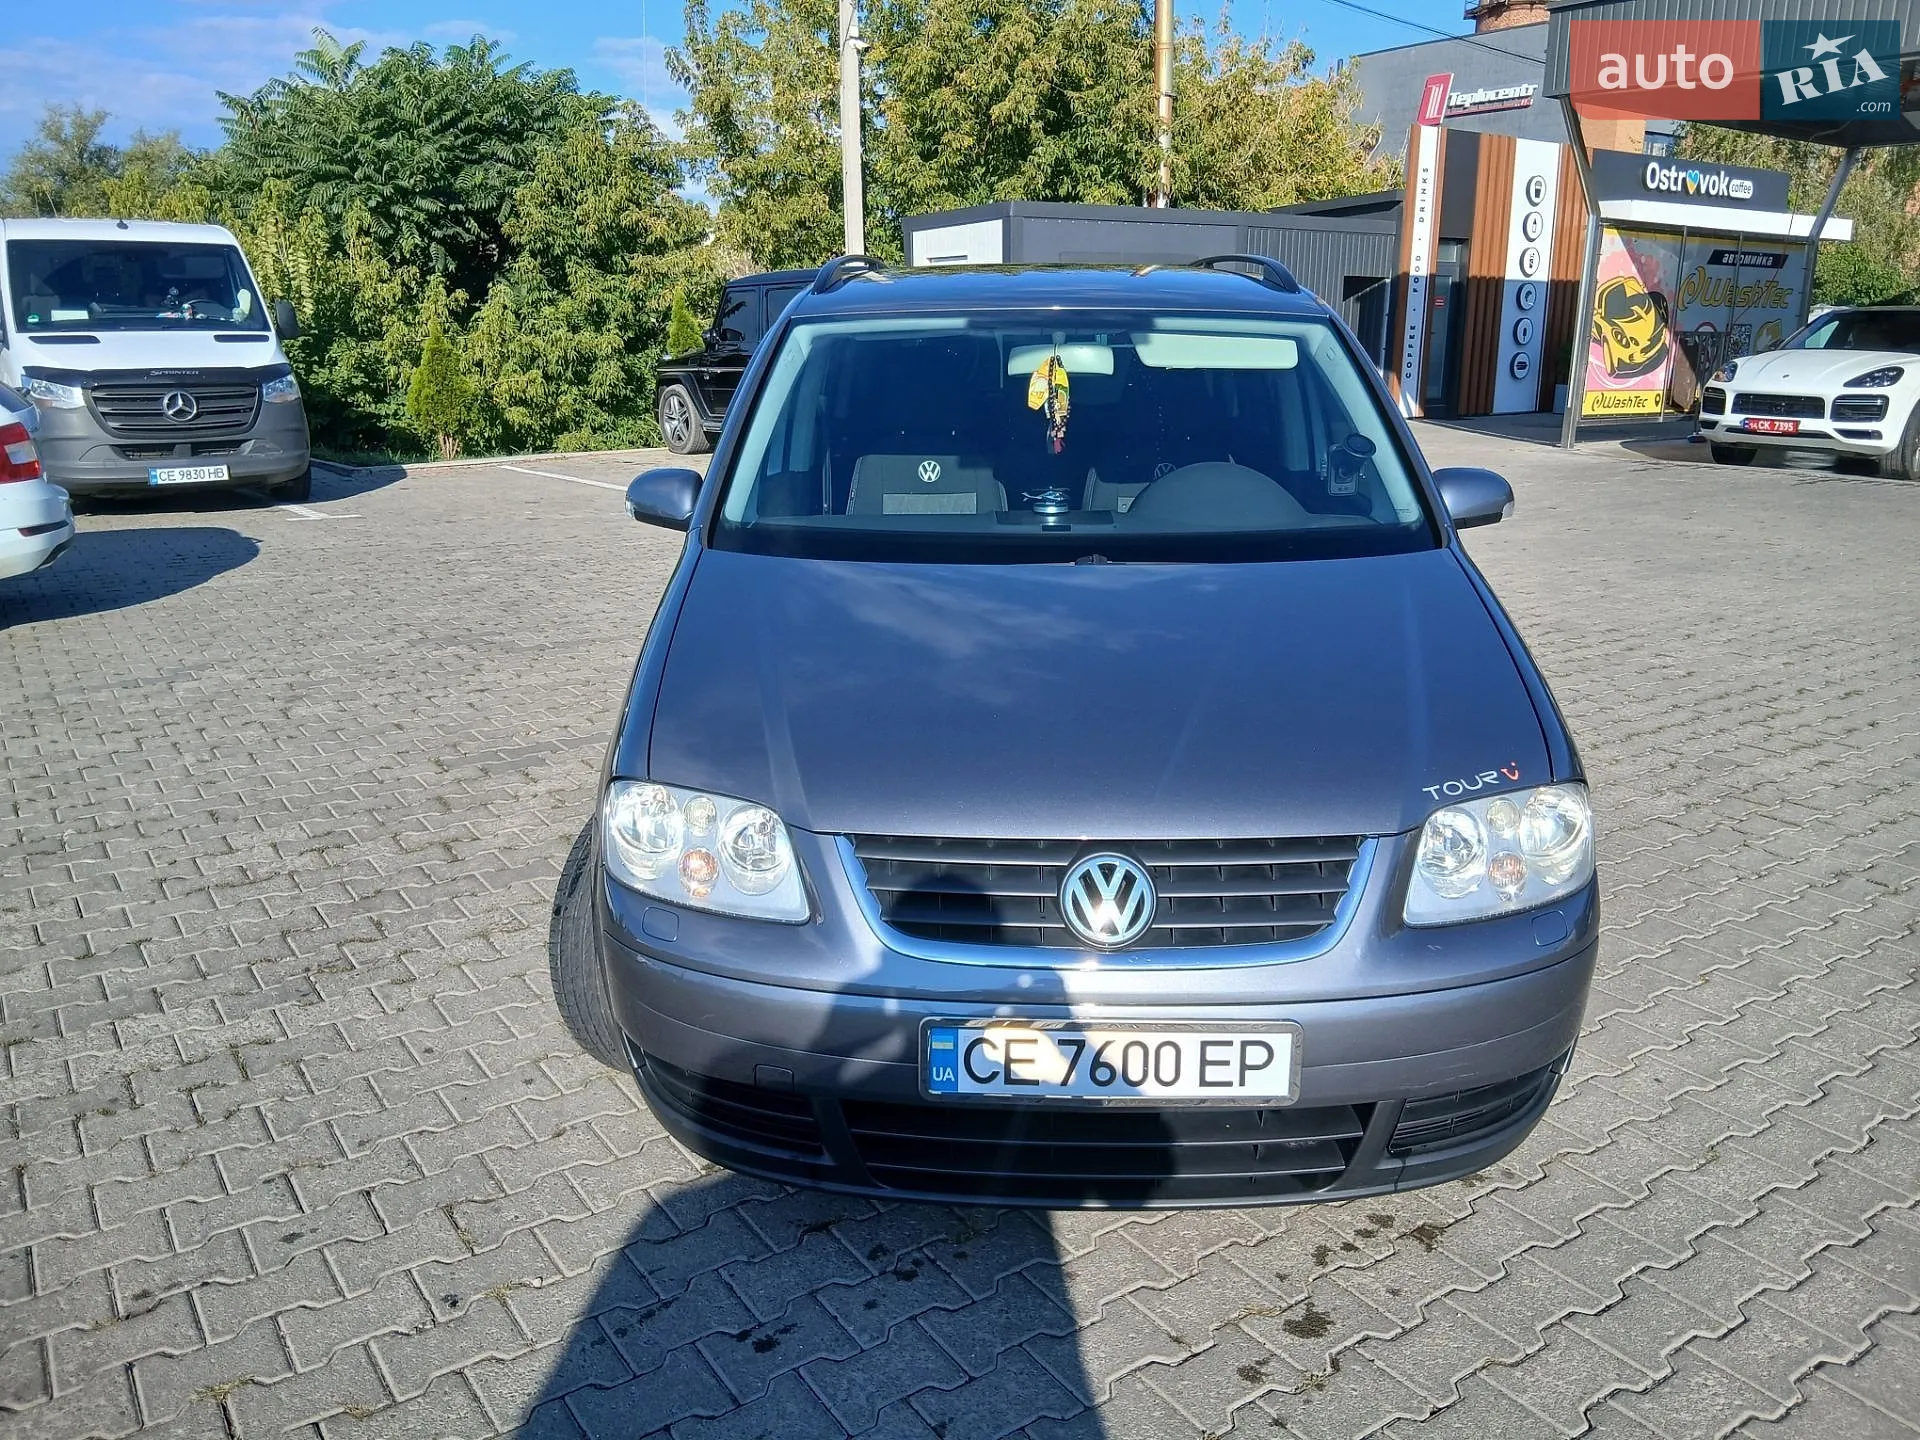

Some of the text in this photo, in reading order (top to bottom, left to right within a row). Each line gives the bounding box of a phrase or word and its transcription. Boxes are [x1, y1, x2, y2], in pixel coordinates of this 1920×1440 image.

[1731, 181, 1752, 195] coffee
[1405, 167, 1429, 379] COFFEE FOOD DRINKS
[1699, 277, 1794, 309] WashTec
[1602, 395, 1649, 409] WashTec
[1758, 420, 1771, 430] CK
[1773, 421, 1794, 431] 7395
[159, 471, 177, 482] CE
[178, 469, 206, 481] 9830
[207, 467, 225, 479] HB
[932, 1036, 1275, 1088] UA CE 7600 EP
